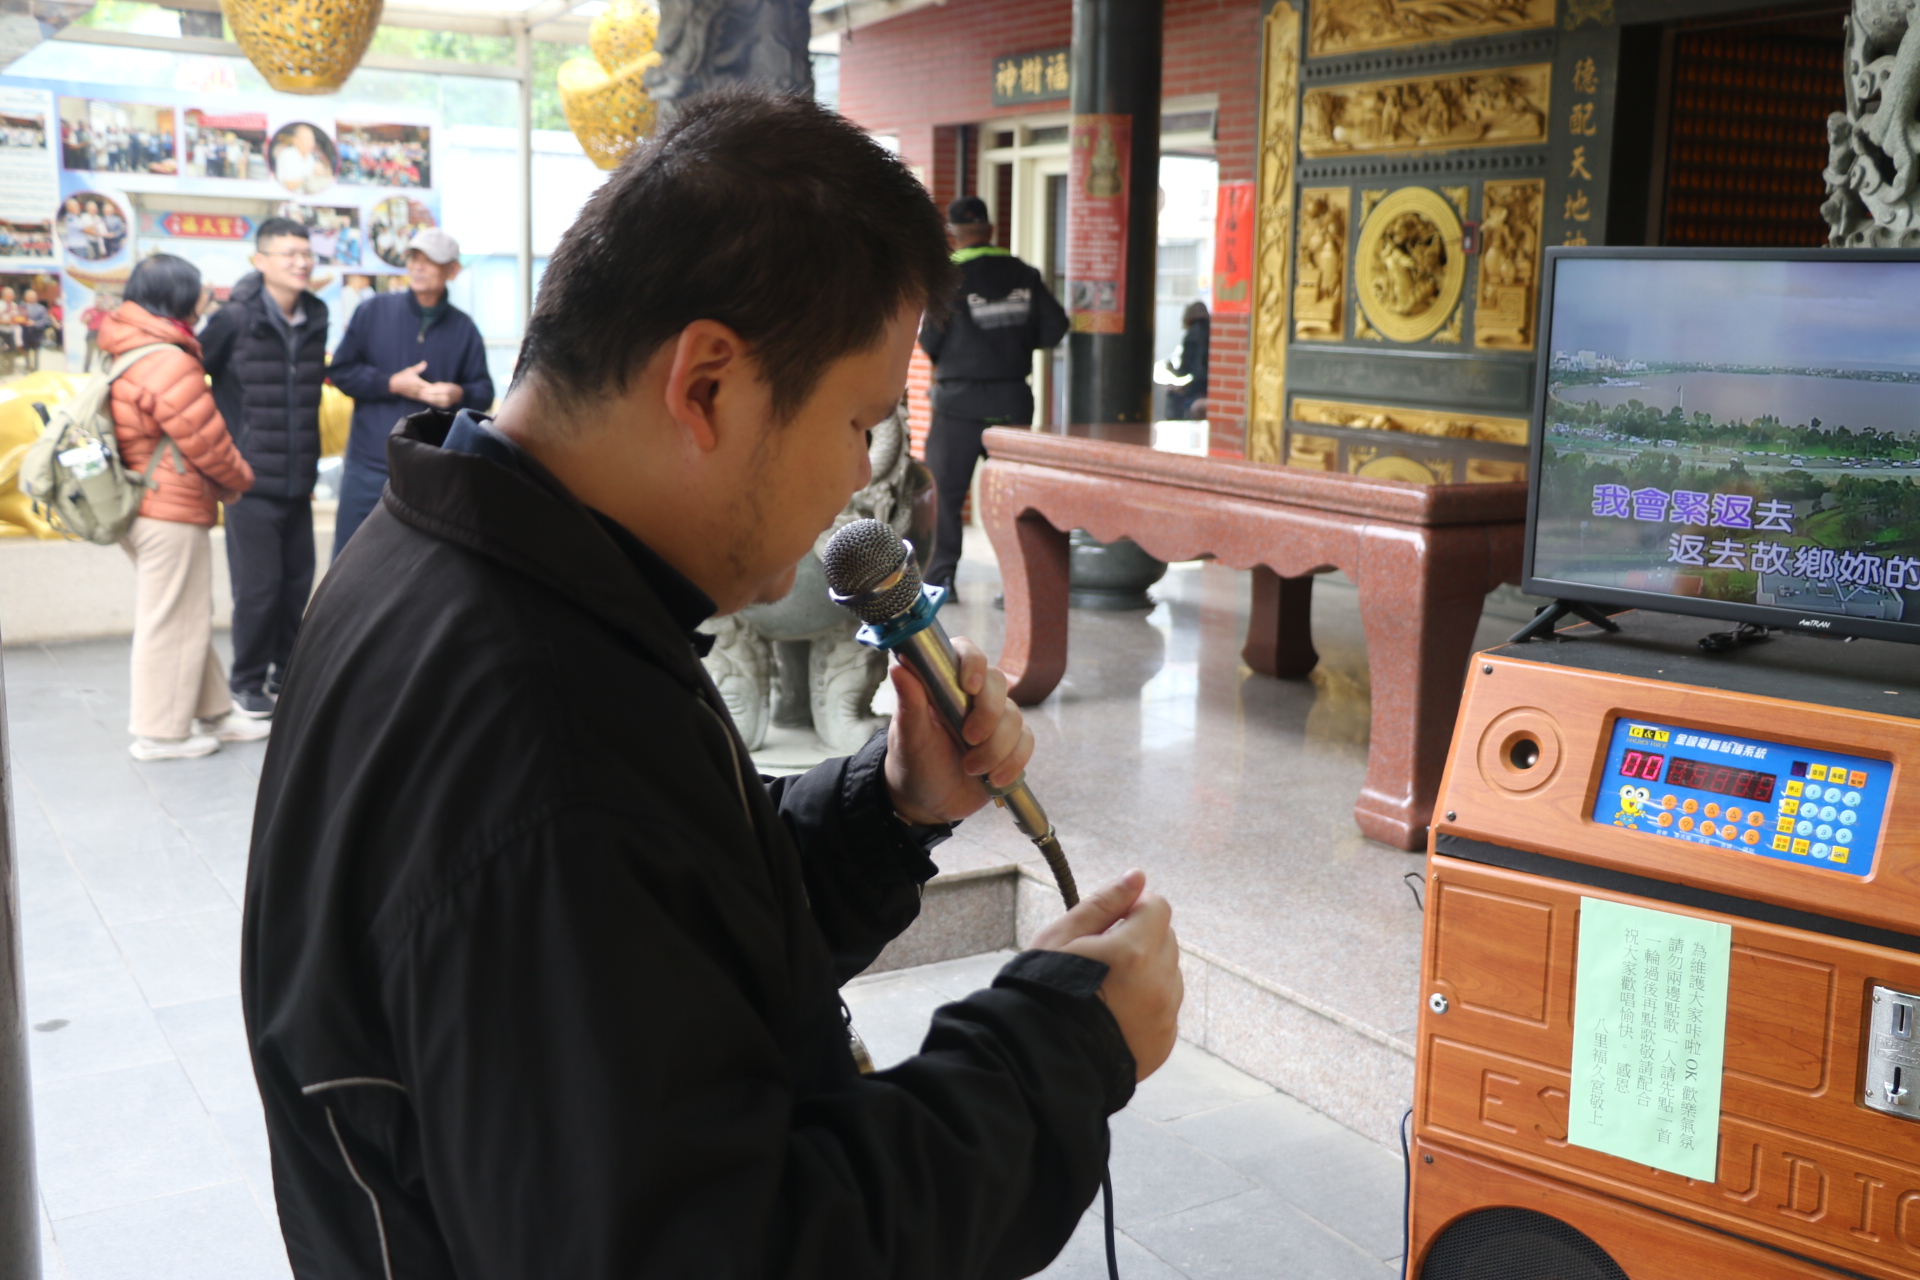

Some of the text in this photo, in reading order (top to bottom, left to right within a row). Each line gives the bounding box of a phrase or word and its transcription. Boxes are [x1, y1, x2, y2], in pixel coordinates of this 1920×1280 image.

[1592, 483, 1794, 534] 我會緊返去
[1667, 532, 1920, 591] 返去故鄉妳的
[1798, 618, 1831, 629] AmTRAN
[1626, 737, 1668, 749] GOLDEN VOICE
[1587, 1018, 1610, 1127] 八里福久宮敬上
